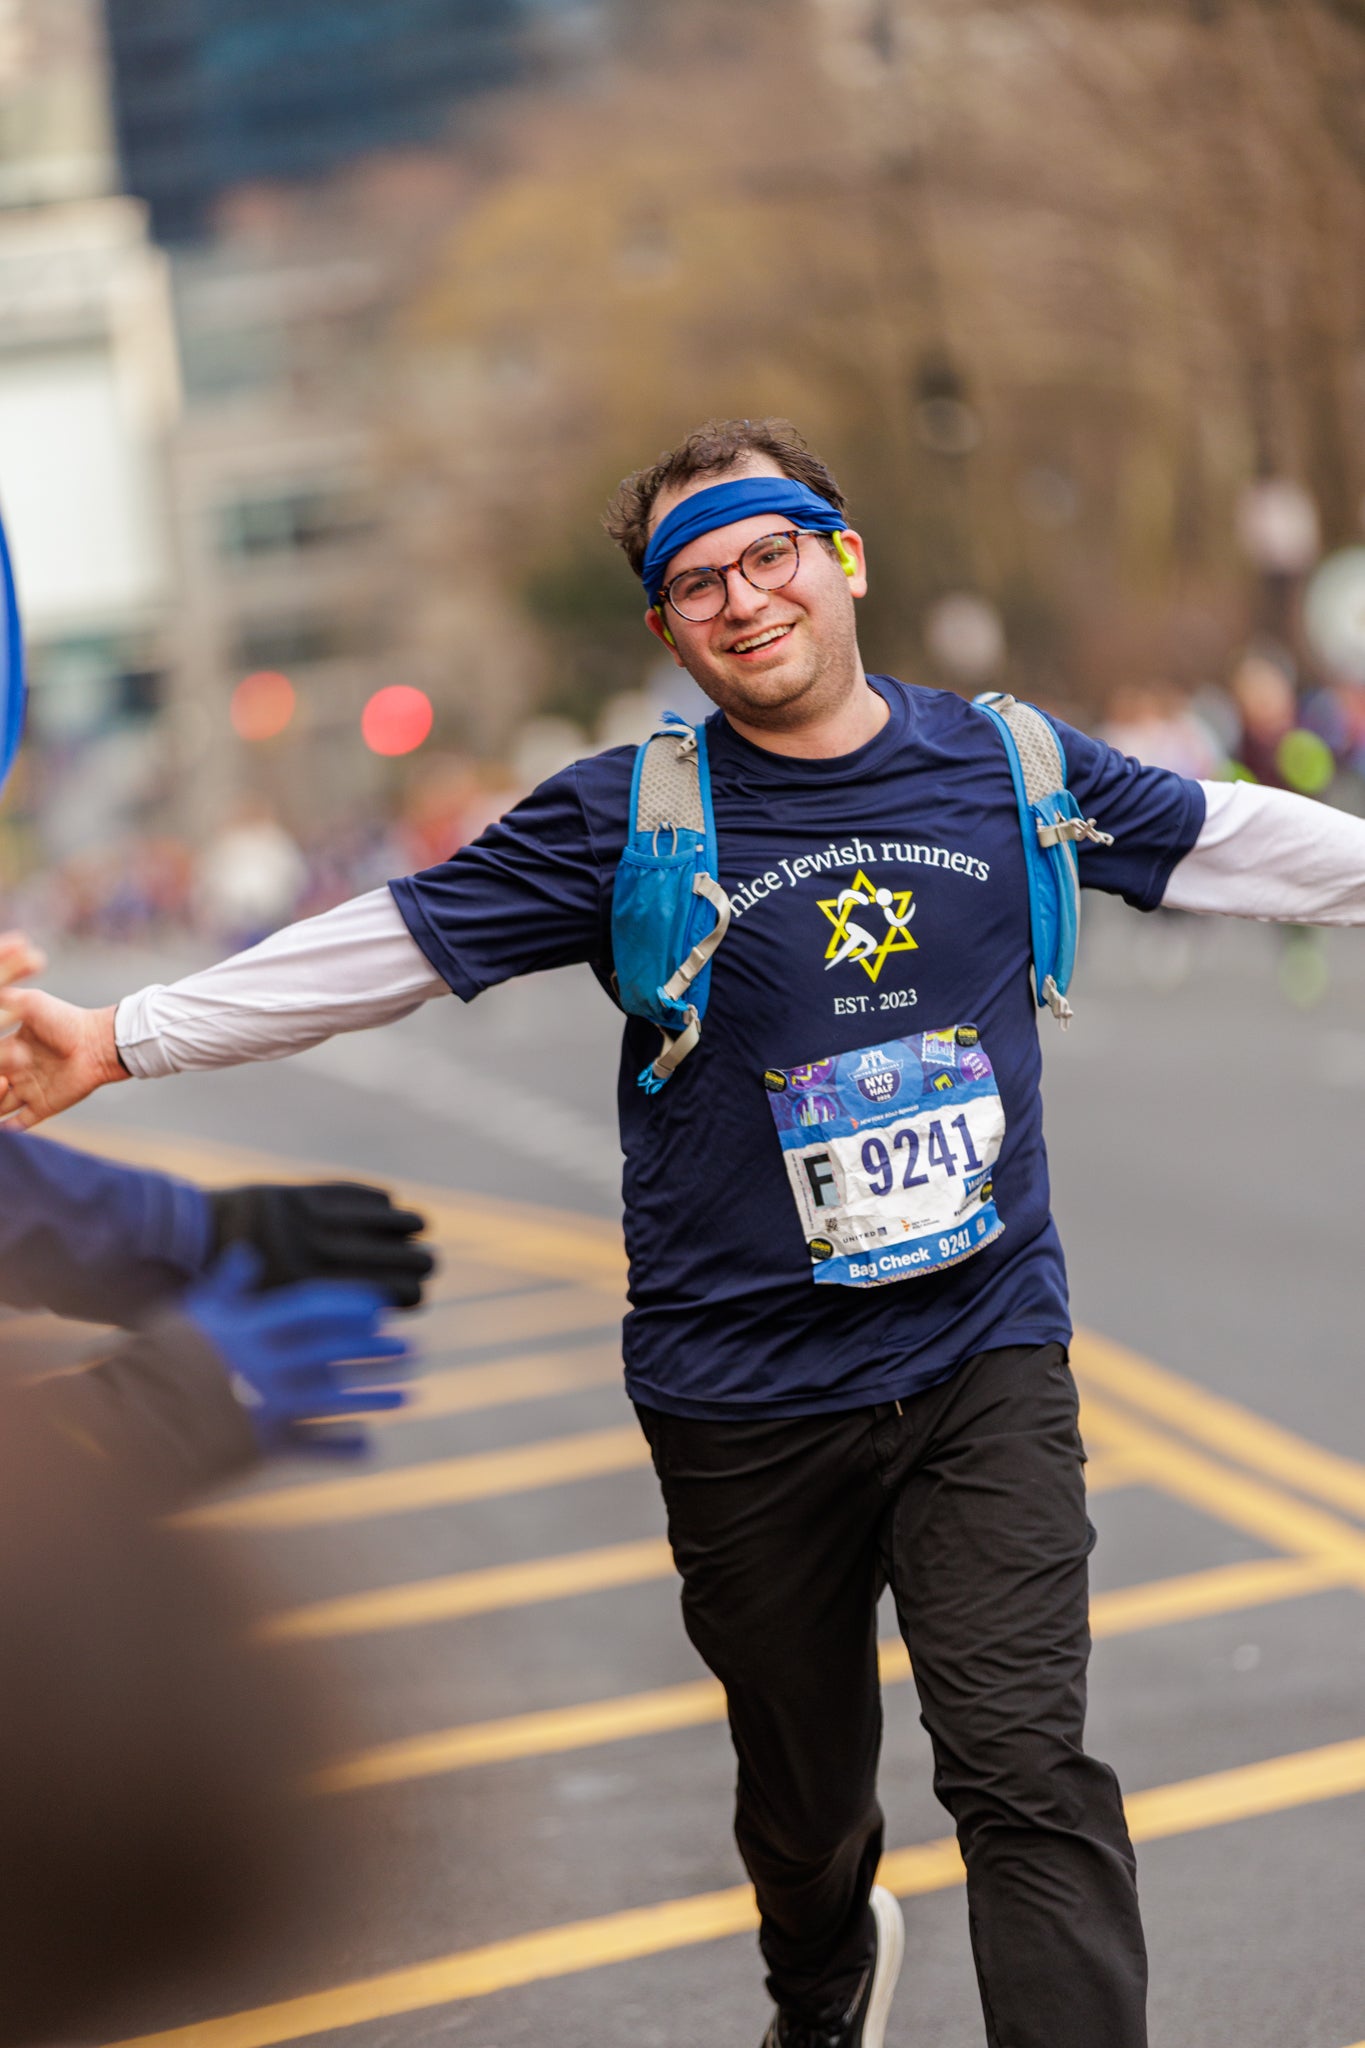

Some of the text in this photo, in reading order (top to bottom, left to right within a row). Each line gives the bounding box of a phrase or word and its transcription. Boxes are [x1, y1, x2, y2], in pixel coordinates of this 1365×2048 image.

[728, 837, 990, 917] nice Jewish runners
[833, 988, 918, 1015] EST. 2023
[864, 1072, 894, 1090] NYC
[869, 1083, 893, 1097] HALF
[861, 1114, 983, 1197] 9241
[803, 1153, 834, 1207] F
[842, 1231, 876, 1244] UNITED
[849, 1228, 972, 1279] Bag Check 9241
